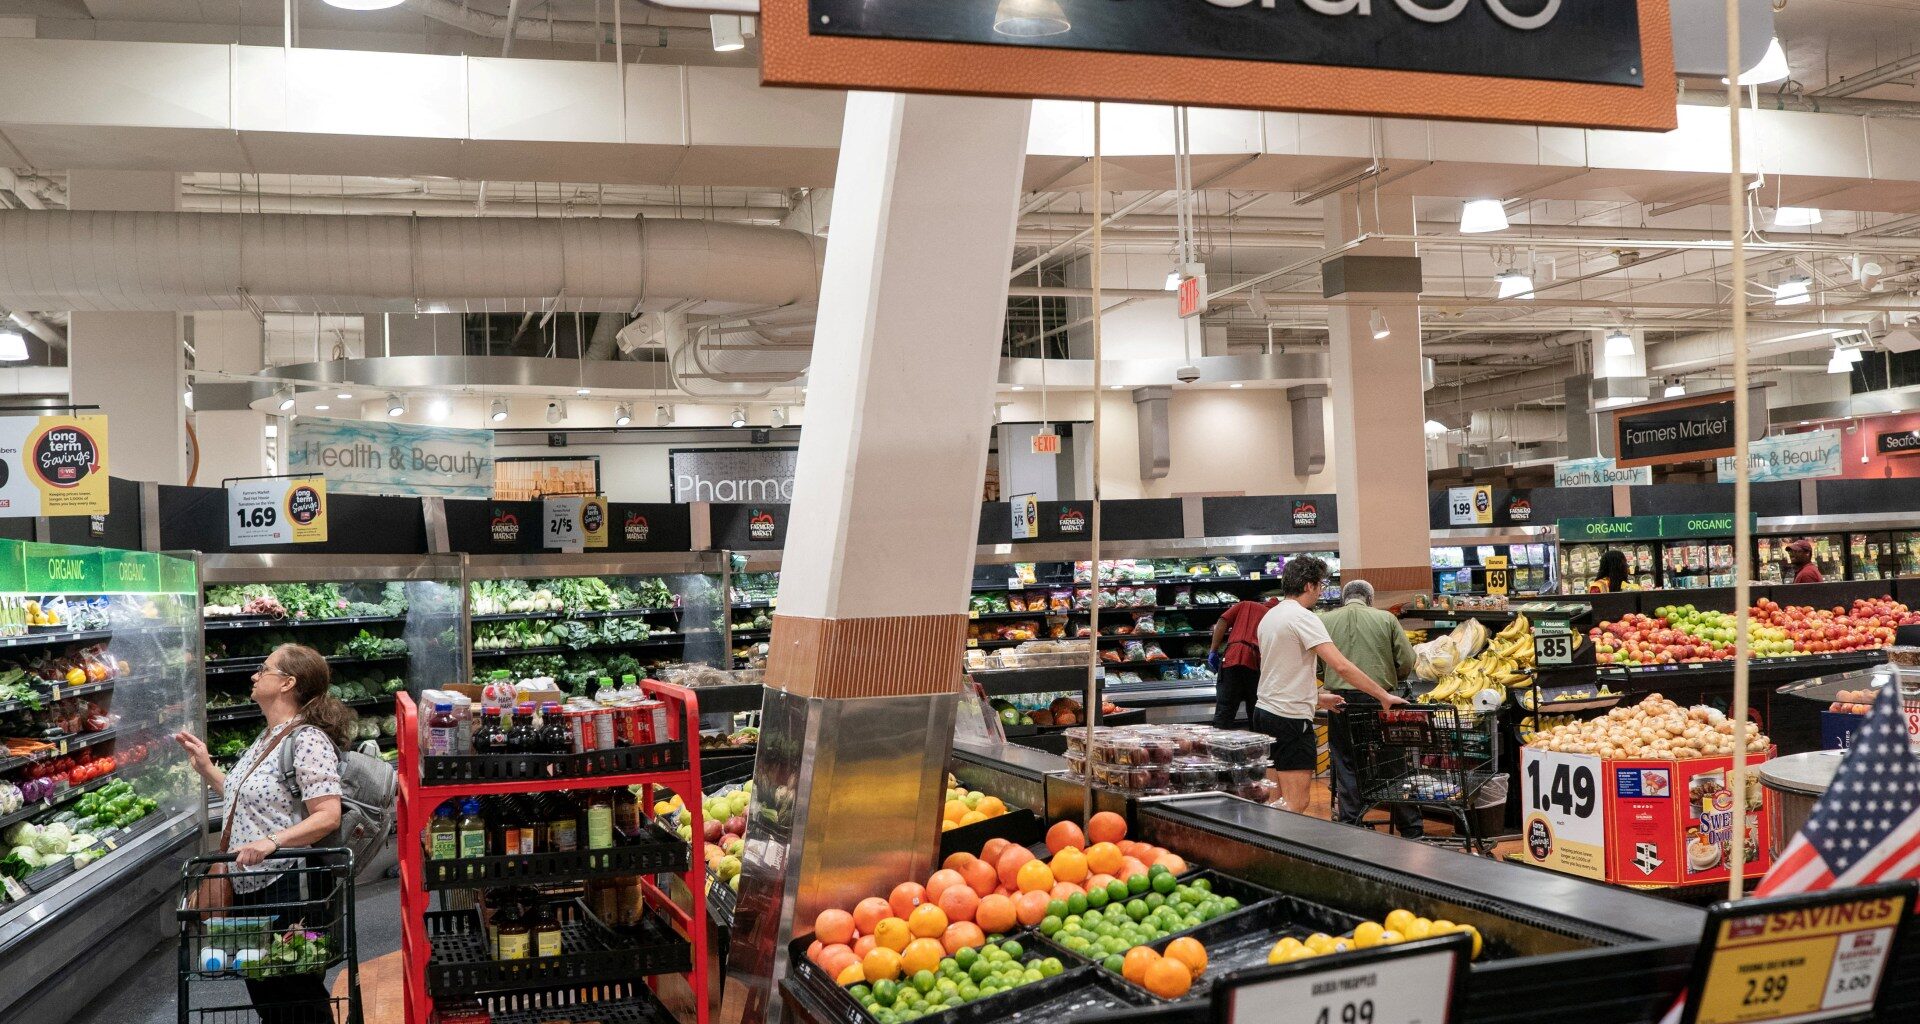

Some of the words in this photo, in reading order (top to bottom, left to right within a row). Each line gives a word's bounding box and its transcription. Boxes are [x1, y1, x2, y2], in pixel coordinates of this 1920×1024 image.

[48, 431, 76, 442] long
[1626, 426, 1676, 445] Farmers
[1680, 416, 1728, 438] Market
[49, 441, 82, 452] term
[1038, 436, 1056, 452] EXIT
[41, 451, 90, 468] Savings
[304, 440, 382, 470] Health
[388, 444, 406, 470] &
[412, 446, 485, 478] Beauty
[1724, 452, 1766, 471] Hlth
[1770, 452, 1780, 466] &
[1783, 446, 1831, 464] Beauty
[1560, 472, 1590, 486] Health
[1594, 470, 1600, 483] &
[1604, 467, 1638, 482] Beauty
[237, 507, 276, 528] 1.69
[1453, 503, 1470, 515] 1.99
[551, 518, 572, 534] 2/$5
[1586, 522, 1632, 534] ORGANIC
[1687, 519, 1732, 531] ORGANIC
[49, 558, 85, 580] ORGANIC
[119, 562, 146, 581] ORGANIC
[1488, 571, 1505, 588] .69
[1537, 638, 1567, 657] .85
[1527, 760, 1596, 818] 1.49
[1700, 812, 1733, 833] SWE
[1771, 901, 1893, 933] SAVINGS
[1742, 975, 1788, 1006] 2.99
[1314, 1000, 1374, 1024] 499
